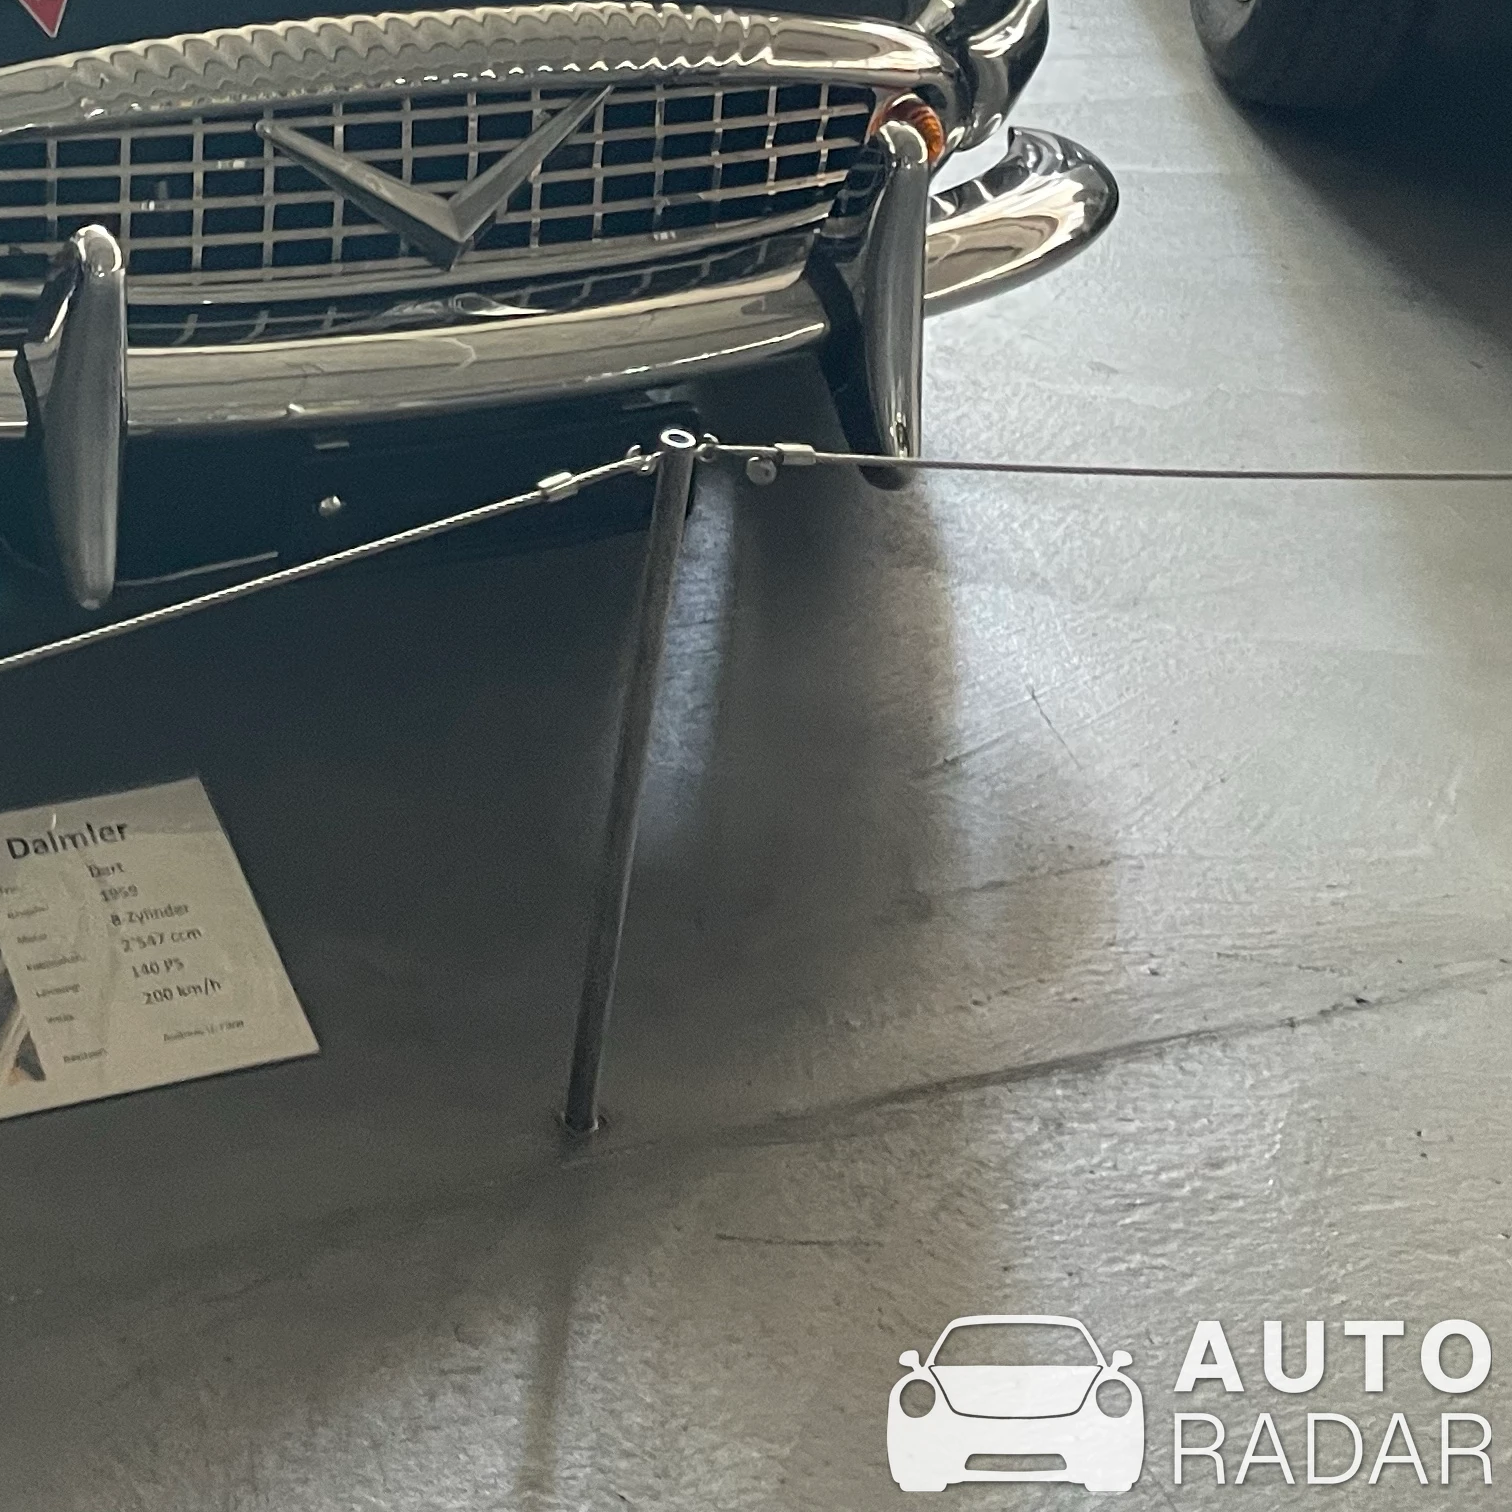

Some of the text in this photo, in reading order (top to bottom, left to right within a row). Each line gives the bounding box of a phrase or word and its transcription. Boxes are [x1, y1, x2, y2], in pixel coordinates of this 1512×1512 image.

[6, 819, 128, 860] Daimler
[170, 928, 202, 943] ccm
[131, 957, 185, 978] 140 PS
[141, 976, 222, 1004] 200 km/h
